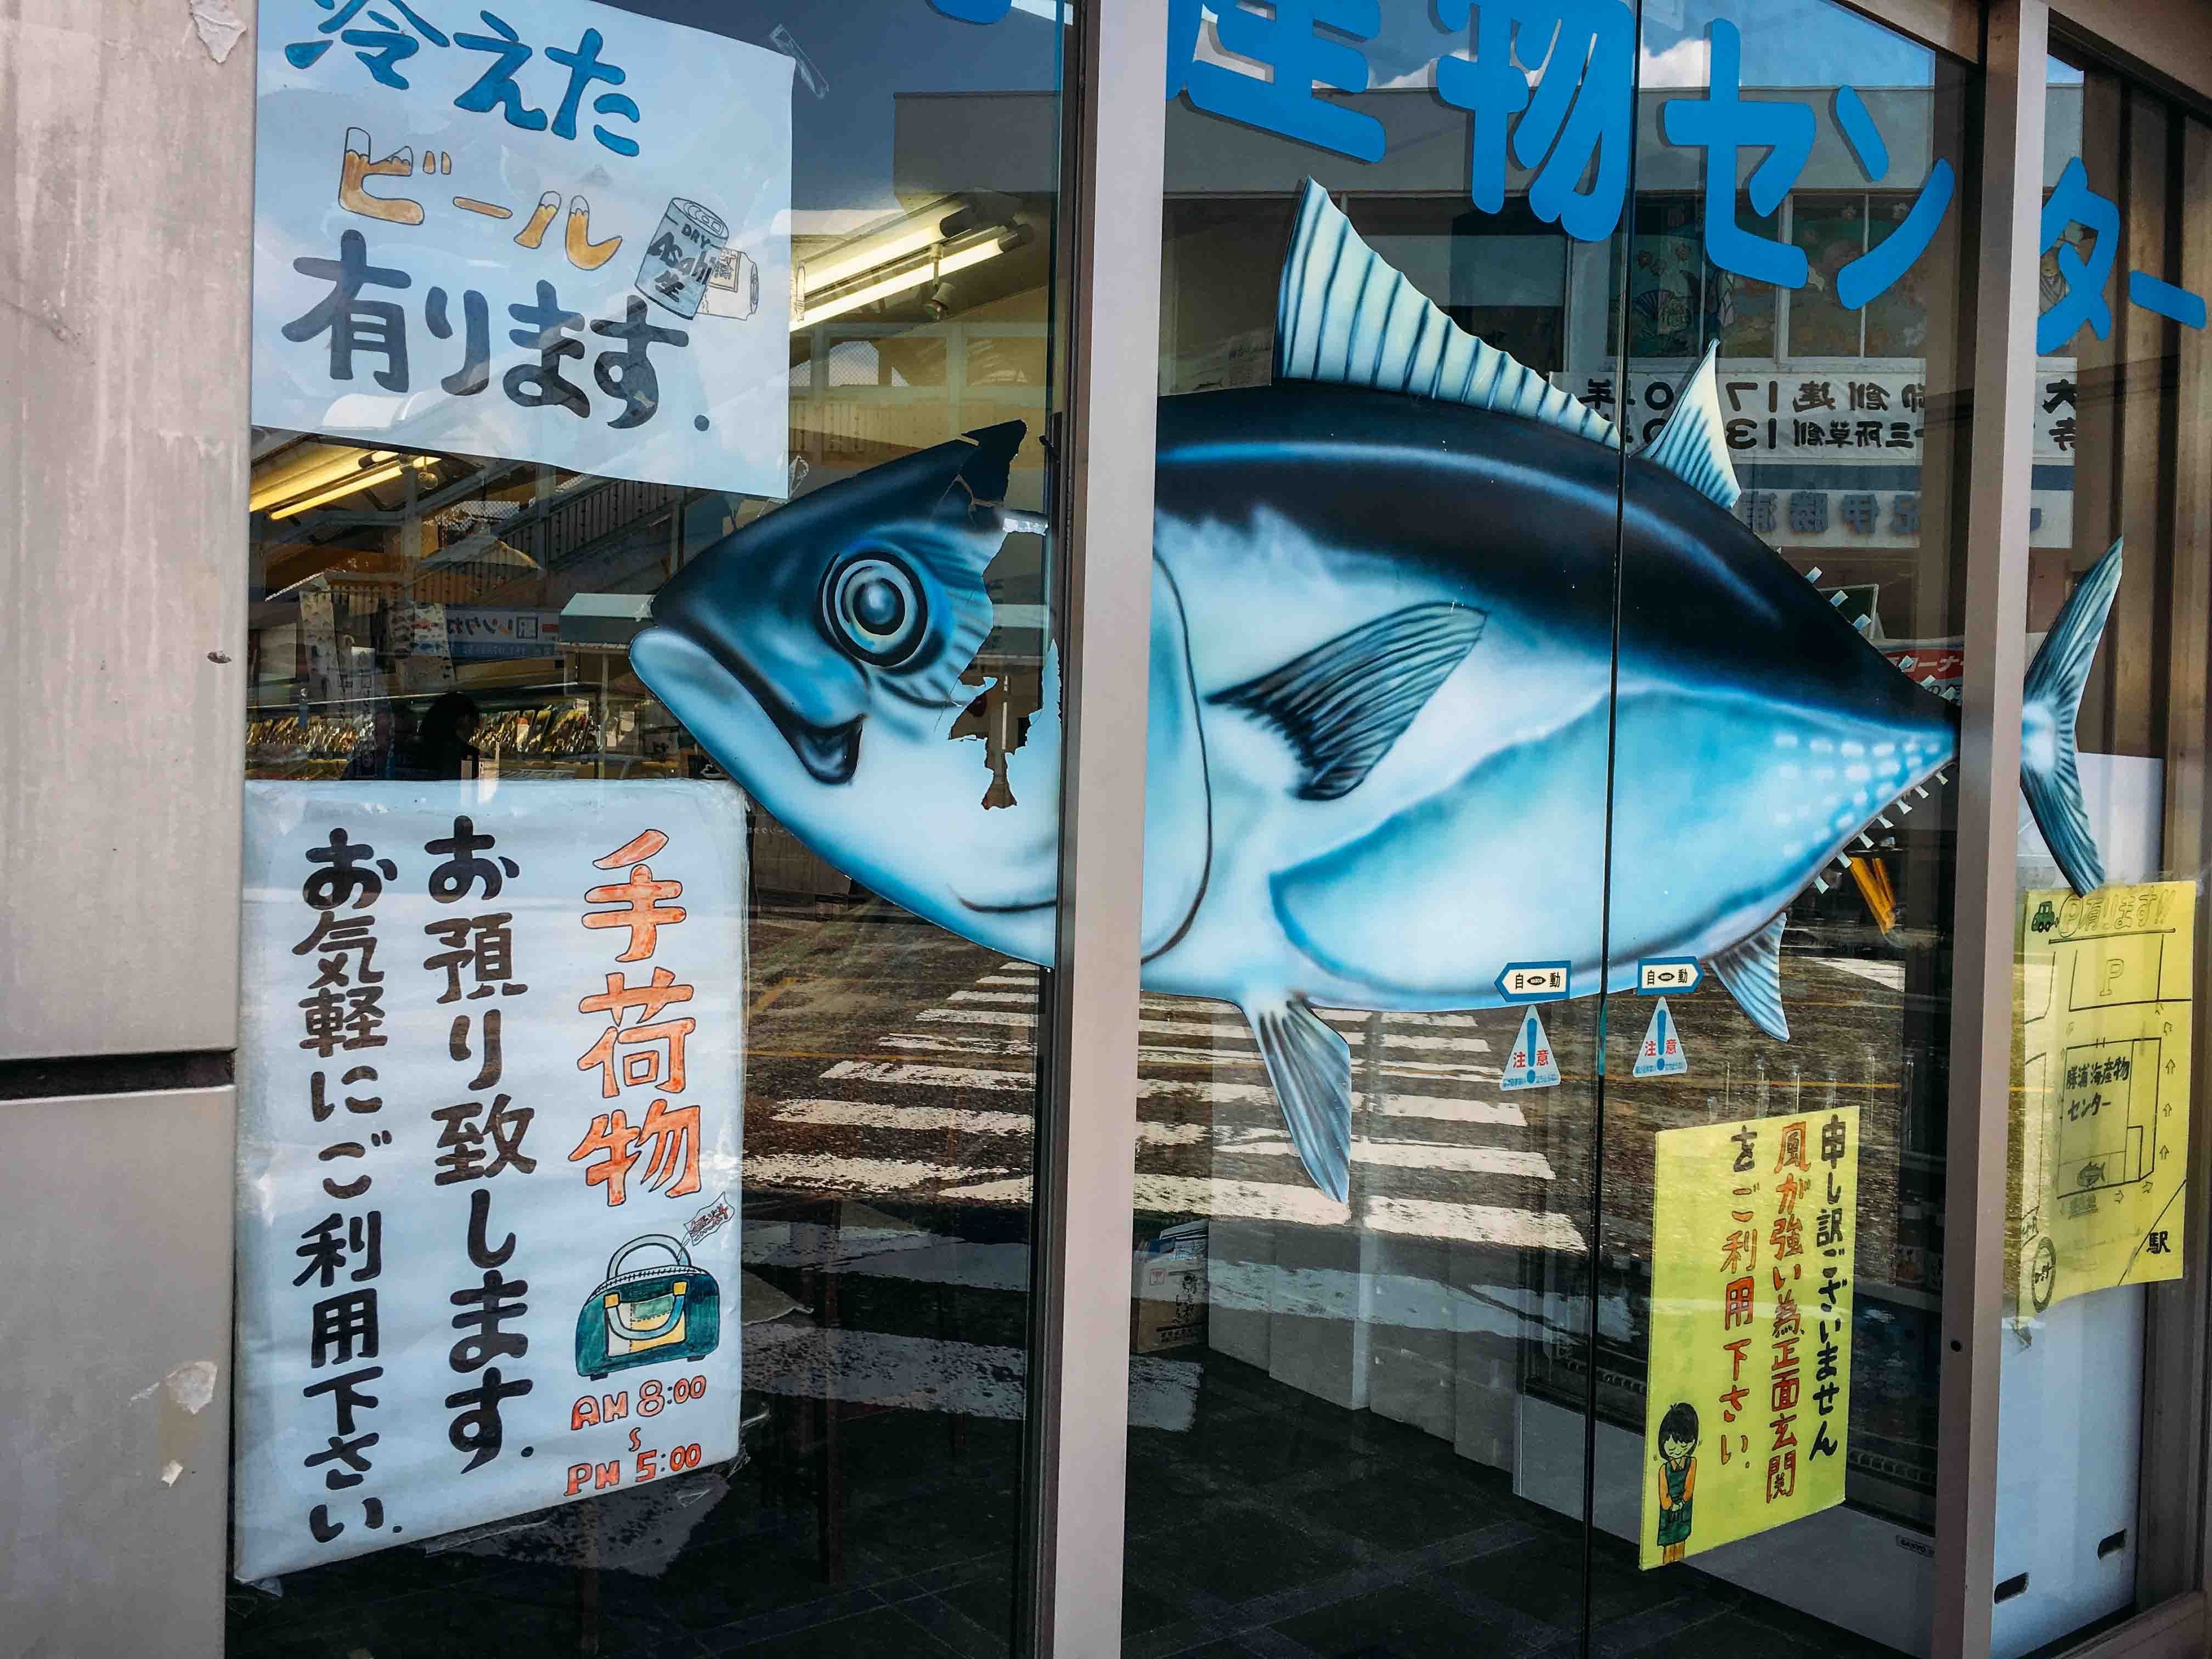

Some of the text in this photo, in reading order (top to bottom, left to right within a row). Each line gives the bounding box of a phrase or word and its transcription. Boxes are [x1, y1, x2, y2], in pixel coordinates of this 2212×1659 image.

[285, 0, 641, 157] 冷えた
[337, 126, 622, 271] ビール
[647, 231, 713, 285] Asahi
[681, 223, 711, 249] DRY
[653, 270, 685, 303] 生
[2099, 957, 2125, 997] P
[567, 827, 704, 1207] 手荷物
[2067, 1092, 2112, 1122] センター
[2146, 1229, 2171, 1256] 駅
[1765, 1121, 1812, 1505] 風が強い為正面玄関
[1809, 1113, 1848, 1462] 申し訳ございません
[571, 1374, 707, 1430] AM 8:00
[563, 1441, 702, 1498] PM 5:00
